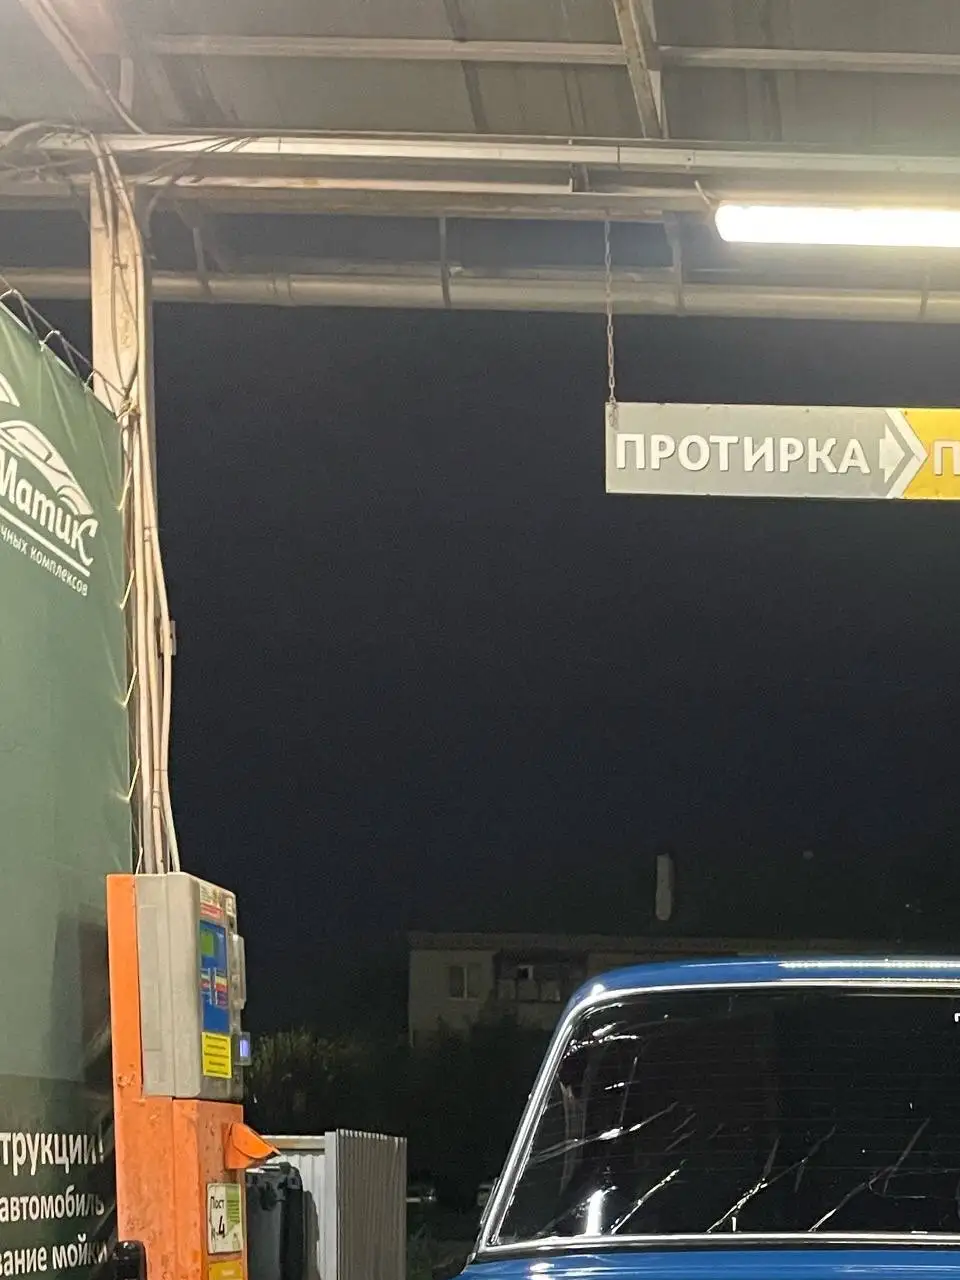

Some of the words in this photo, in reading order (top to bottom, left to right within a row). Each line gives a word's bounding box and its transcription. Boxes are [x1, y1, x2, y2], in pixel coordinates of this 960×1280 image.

[615, 433, 871, 474] ПРОТИРКА
[30, 546, 88, 596] комплексов
[0, 1184, 104, 1223] автомобиль
[52, 1232, 108, 1271] мойки
